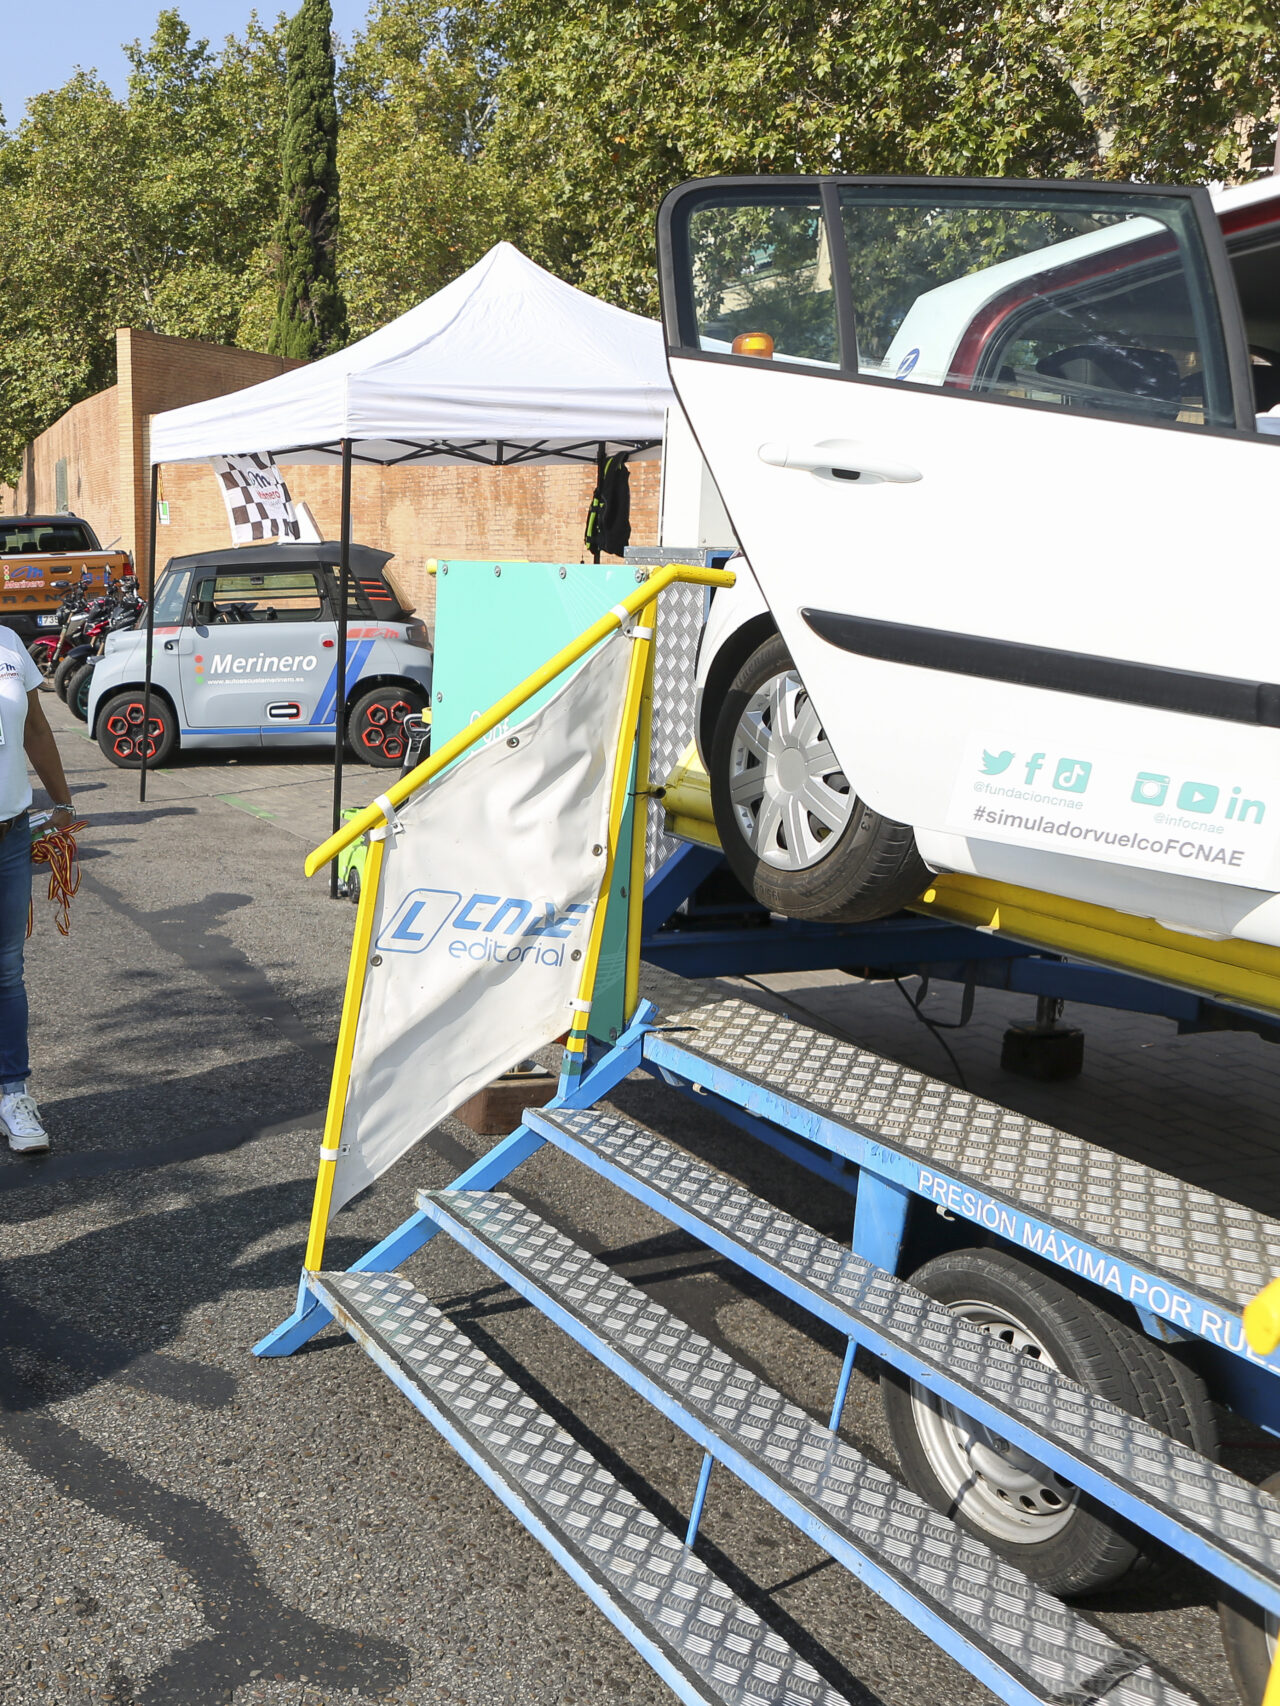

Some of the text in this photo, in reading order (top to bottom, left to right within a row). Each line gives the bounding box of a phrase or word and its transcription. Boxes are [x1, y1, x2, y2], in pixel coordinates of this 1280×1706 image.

[210, 652, 317, 674] Merinero
[973, 781, 1084, 809] @fundacioncnae
[973, 805, 1245, 867] #simuladorvuelcoFCNAE
[1153, 812, 1224, 834] @infocnae
[448, 937, 565, 967] editorial
[918, 1170, 1017, 1237] PRESIÓN
[1022, 1222, 1123, 1293] MÁXIMA
[1128, 1274, 1192, 1328] POR
